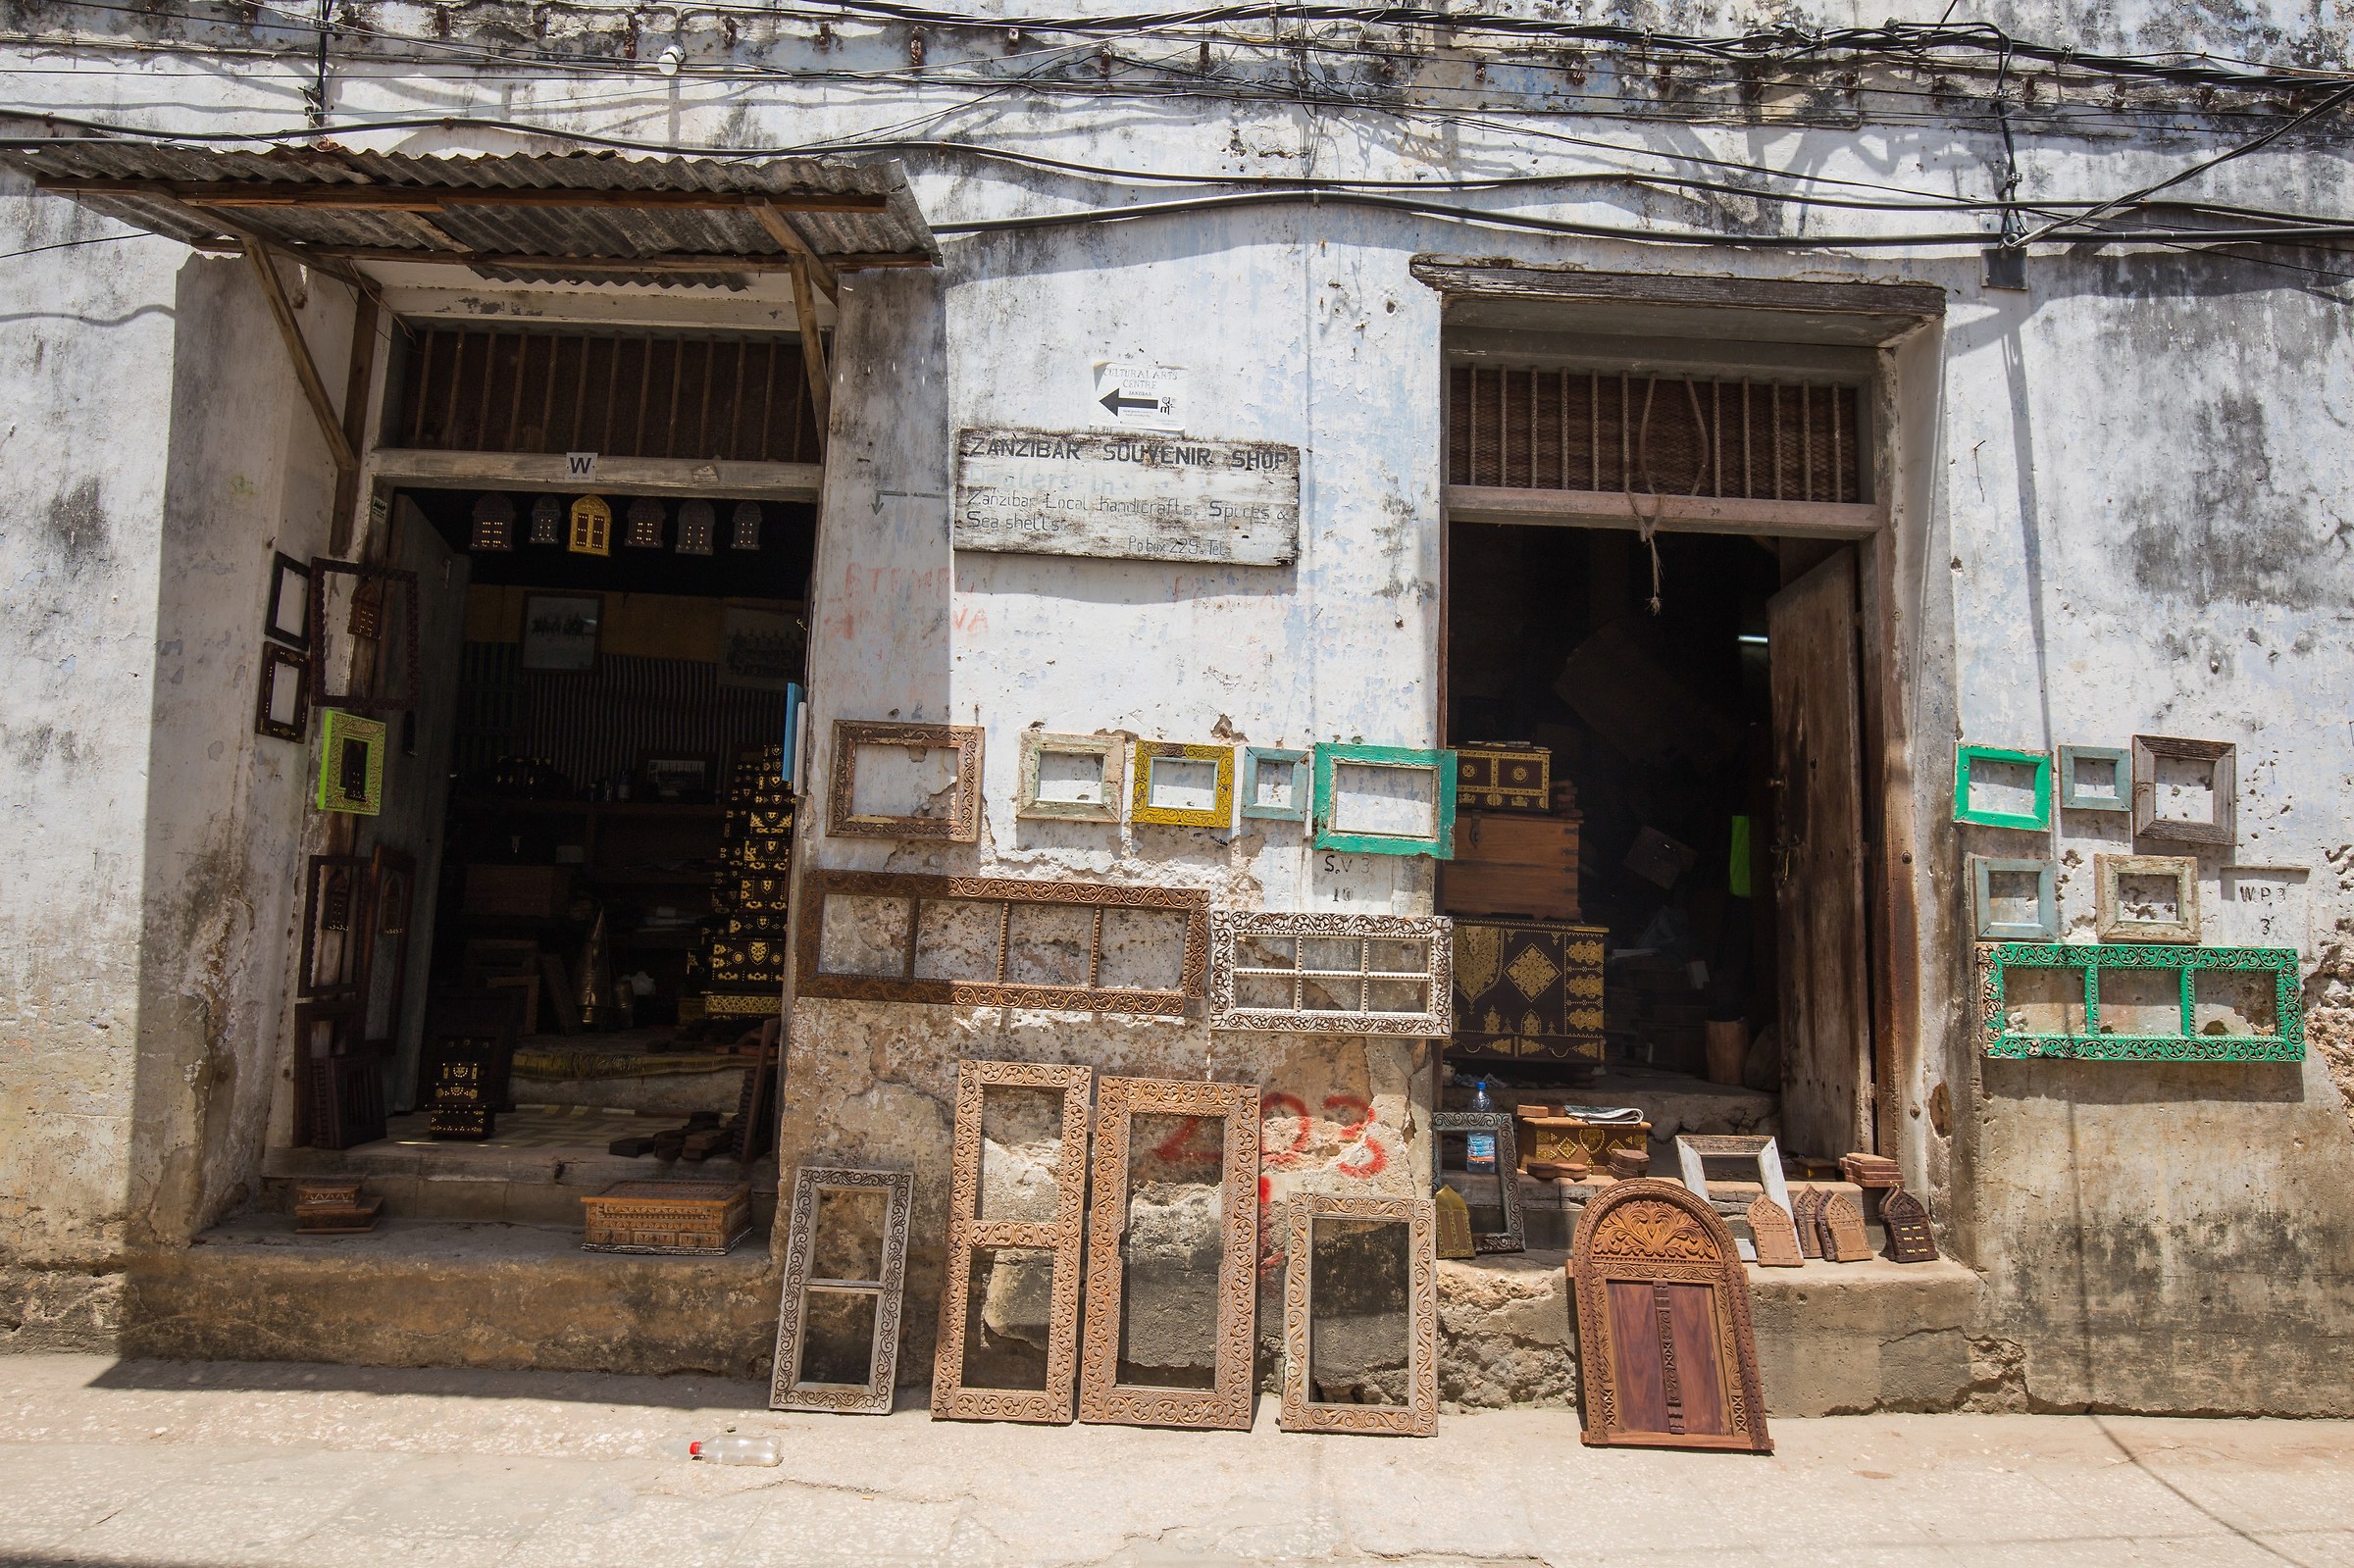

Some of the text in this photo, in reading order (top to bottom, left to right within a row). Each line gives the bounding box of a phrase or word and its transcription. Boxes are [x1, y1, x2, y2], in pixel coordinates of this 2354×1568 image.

[1104, 368, 1178, 380] CULTURAL ARTS
[1122, 379, 1158, 389] CENTRE
[970, 437, 1289, 470] ZANZIBAR SOUVENIR SHOP
[570, 457, 592, 475] W
[967, 489, 1035, 508] Zanzibar
[1046, 493, 1088, 511] Local
[1208, 500, 1270, 524] Spices
[1276, 511, 1289, 521] &
[966, 510, 998, 529] Sea
